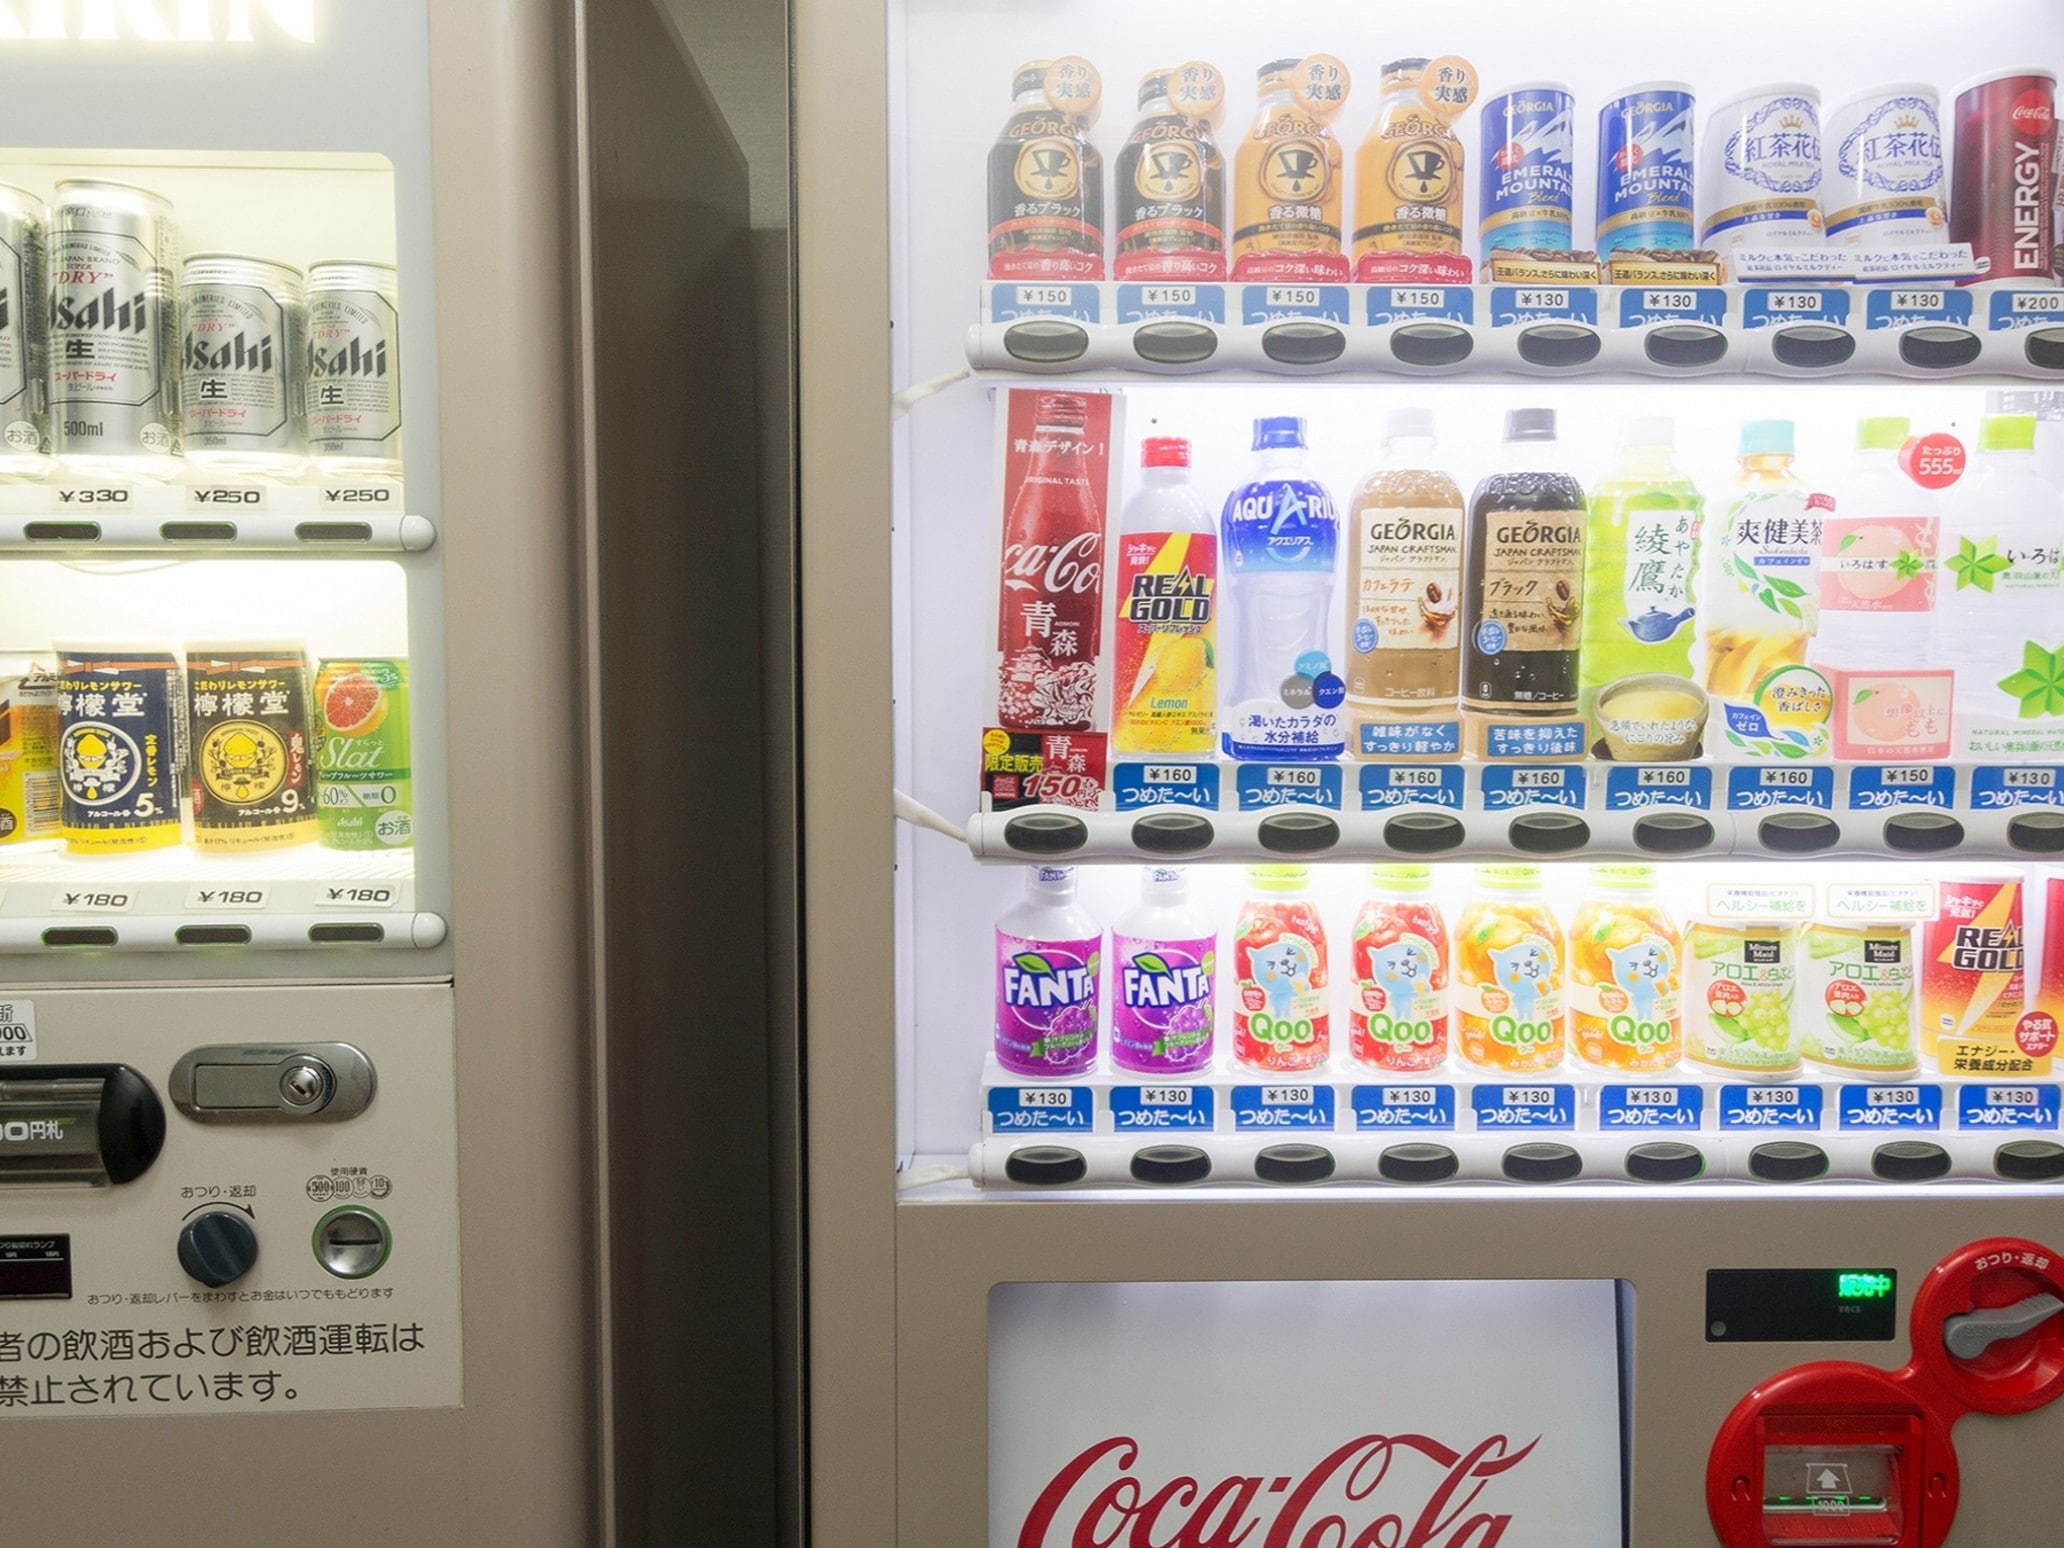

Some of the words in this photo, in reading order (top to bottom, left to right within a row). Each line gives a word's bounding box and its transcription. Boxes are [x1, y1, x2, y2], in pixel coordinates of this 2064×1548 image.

[1057, 63, 1089, 80] 香り
[1183, 67, 1212, 82] 香り
[1307, 63, 1339, 81] 香り
[1438, 67, 1466, 84] 香り
[1056, 82, 1091, 99] 実感
[1179, 84, 1216, 102] 実感
[1306, 83, 1341, 101] 実感
[1434, 86, 1468, 103] 実感
[1014, 202, 1080, 217] 香るブラック
[1135, 203, 1204, 221] 香るブラック
[2014, 142, 2040, 270] ENERGY
[1854, 251, 1968, 263] ミルクに本気でこだわった
[1023, 290, 1067, 302] ¥150
[1148, 289, 1191, 302] ¥150
[1271, 291, 1315, 303] ¥150
[1396, 292, 1439, 304] ¥150
[1521, 293, 1563, 306] ¥130
[1649, 295, 1691, 307] ¥130
[1774, 296, 1816, 308] ¥130
[1897, 295, 1939, 307] ¥130
[2018, 298, 2059, 309] ¥200
[65, 340, 95, 360] 生
[54, 371, 117, 382] スーパードライ
[201, 379, 227, 399] 生
[321, 386, 344, 405] 生
[190, 408, 246, 419] スーパードライ
[64, 421, 103, 437] 500ml
[6, 428, 38, 447] お酒
[1922, 446, 1960, 456] たっぷり
[58, 488, 128, 503] ¥330
[194, 490, 260, 504] ¥250
[325, 488, 390, 502] ¥250
[1370, 516, 1456, 541] GEORGIA
[1497, 519, 1581, 544] GEORGIA
[1737, 519, 1823, 545] 爽健美茶
[1267, 536, 1314, 546] アクエリアス
[1368, 545, 1399, 554] JAPAN
[1493, 548, 1527, 557] JAPAN
[1629, 523, 1672, 595] 綾鷹
[1669, 517, 1690, 599] あやたか
[1840, 559, 1888, 570] いろはす
[1132, 564, 1210, 597] REAL
[1363, 578, 1414, 593] カフェラテ
[1489, 579, 1538, 596] ブラック
[1130, 597, 1210, 622] GOLD
[1385, 688, 1435, 697] コーヒー飲料
[1772, 687, 1825, 699] 澄みきった
[1150, 697, 1188, 709] Lemon
[1779, 702, 1822, 712] 香ばしさ
[1731, 712, 1762, 720] カフェイン
[1373, 724, 1444, 738] 雑味がなく
[1736, 721, 1759, 731] ゼロ
[1264, 730, 1319, 744] 水分補給
[1493, 727, 1578, 741] 苦味を抑えた
[320, 737, 384, 769] Slat
[1364, 740, 1456, 753] すっきり軽やか
[1497, 741, 1576, 754] すっきり後味
[985, 753, 1044, 773] 限定販売
[1149, 769, 1191, 781] ¥160
[1273, 771, 1316, 783] ¥160
[1394, 771, 1436, 783] ¥160
[1517, 772, 1559, 784] ¥160
[1643, 771, 1685, 783] ¥160
[1765, 771, 1807, 784] ¥160
[1886, 770, 1928, 781] ¥150
[2008, 772, 2050, 784] ¥130
[1122, 788, 1210, 803] つめた～い
[1245, 788, 1333, 804] つめた～い
[1368, 789, 1454, 804] つめた～い
[1489, 789, 1576, 805] つめた～い
[1614, 790, 1701, 806] つめた～い
[1736, 791, 1823, 806] つめた～い
[1858, 790, 1944, 806] つめた～い
[377, 818, 411, 836] お酒
[62, 893, 128, 907] ¥180
[198, 890, 262, 904] ¥180
[327, 888, 390, 902] ¥180
[1716, 899, 1807, 913] ヘルシー補給を
[1836, 899, 1926, 913] ヘルシー補給を
[1748, 943, 1778, 952] Minute
[1868, 943, 1898, 952] Minute
[1753, 951, 1774, 959] Maid
[1873, 951, 1895, 959] Maid
[1004, 966, 1094, 1006] FANTA
[1123, 966, 1210, 1006] FANTA
[1250, 1012, 1312, 1042] Qoo
[1370, 1012, 1431, 1042] Qoo
[1492, 1015, 1552, 1044] Qoo
[1611, 1014, 1670, 1044] Qoo
[2021, 1019, 2052, 1031] やる気
[2018, 1031, 2055, 1042] サポート
[1954, 1058, 2033, 1071] 栄養成分配合
[1025, 1092, 1067, 1104] ¥130
[1145, 1090, 1187, 1102] ¥130
[1267, 1089, 1309, 1101] ¥130
[1389, 1091, 1431, 1102] ¥130
[1508, 1091, 1550, 1103] ¥130
[1631, 1091, 1672, 1103] ¥130
[1753, 1090, 1794, 1102] ¥130
[1873, 1090, 1914, 1103] ¥130
[1992, 1091, 2033, 1103] ¥130
[997, 1110, 1084, 1126] つめた～い
[1118, 1110, 1205, 1126] つめた～い
[1239, 1108, 1326, 1124] つめた～い
[1360, 1108, 1446, 1124] つめた～い
[1480, 1108, 1566, 1124] つめた～い
[1608, 1108, 1694, 1124] つめた～い
[1728, 1108, 1814, 1124] つめた～い
[1847, 1108, 1933, 1124] つめた～い
[1966, 1108, 2051, 1124] つめた～い
[180, 1185, 256, 1198] おつり・返却
[312, 1181, 330, 1193] 500
[335, 1181, 350, 1193] 100
[1975, 1251, 2050, 1271] おつり・返却
[87, 1288, 393, 1305] おつり・返却レバーをまわすとお金はいつでももどります
[0, 1322, 425, 1363] 者の飲酒および飲酒運転は
[0, 1370, 298, 1407] 禁止されています。
